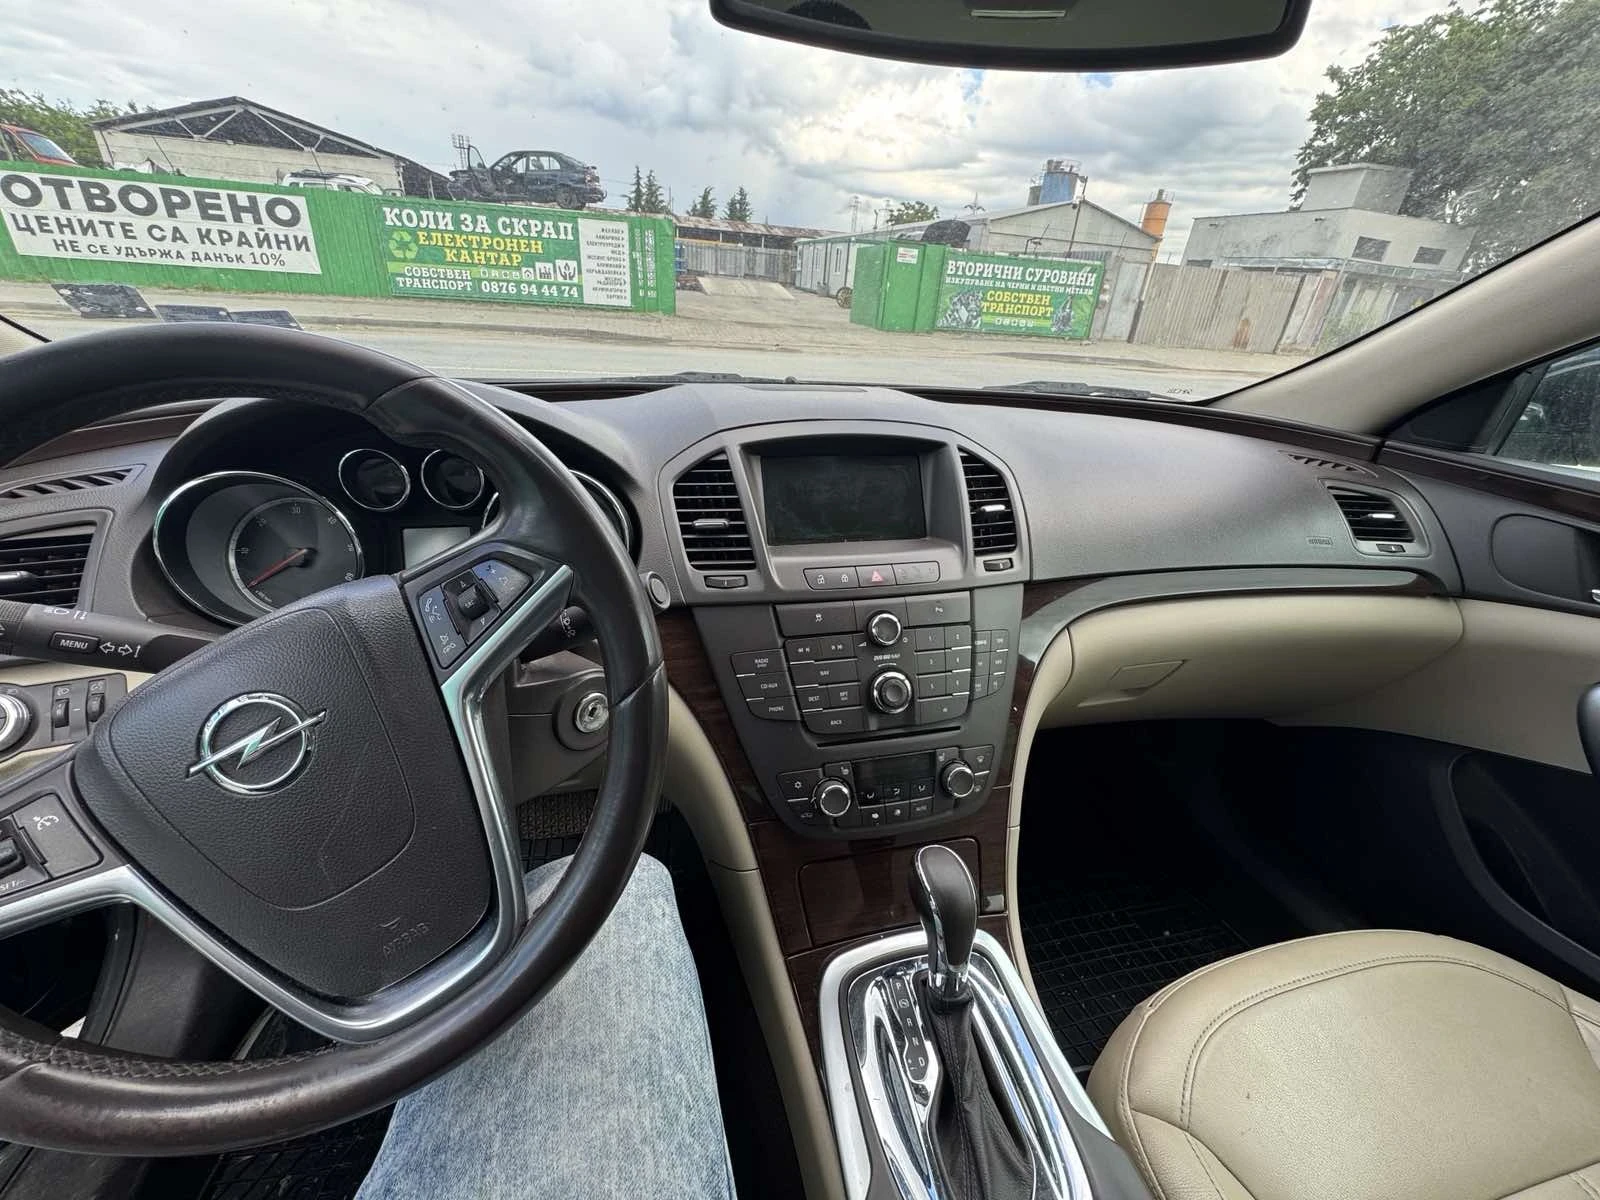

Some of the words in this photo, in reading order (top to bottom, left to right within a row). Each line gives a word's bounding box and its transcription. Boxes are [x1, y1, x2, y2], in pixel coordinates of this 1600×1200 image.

[0, 174, 301, 228] ОТВОРЕНО
[10, 213, 138, 240] ЦЕНИТЕ
[147, 224, 188, 245] СА
[197, 227, 311, 252] КРАЙНИ
[382, 207, 453, 231] КОЛИ
[460, 212, 492, 233] ЗА
[497, 216, 577, 240] СКРАП
[416, 231, 544, 253] ЕЛЕКТРОНЕН
[53, 238, 82, 253] НЕ
[87, 243, 110, 255] СЕ
[114, 246, 184, 261] УДЪРЖА
[191, 251, 245, 264] ДАНЪК
[250, 251, 286, 267] 10%
[444, 248, 522, 267] КАНТАР
[404, 266, 473, 281] СОБСТВЕН
[947, 260, 1023, 280] ВТОРИЧНИ
[1025, 268, 1096, 287] СУРОВИНИ
[396, 277, 473, 292] ТРАНСПОРТ
[481, 280, 518, 295] 0876
[521, 282, 539, 296] 94
[542, 284, 560, 297] 44
[561, 285, 579, 298] 74
[987, 290, 1051, 306] СОБСТВЕН
[982, 301, 1054, 317] ТРАНСПОРТ
[60, 639, 88, 649] MENU
